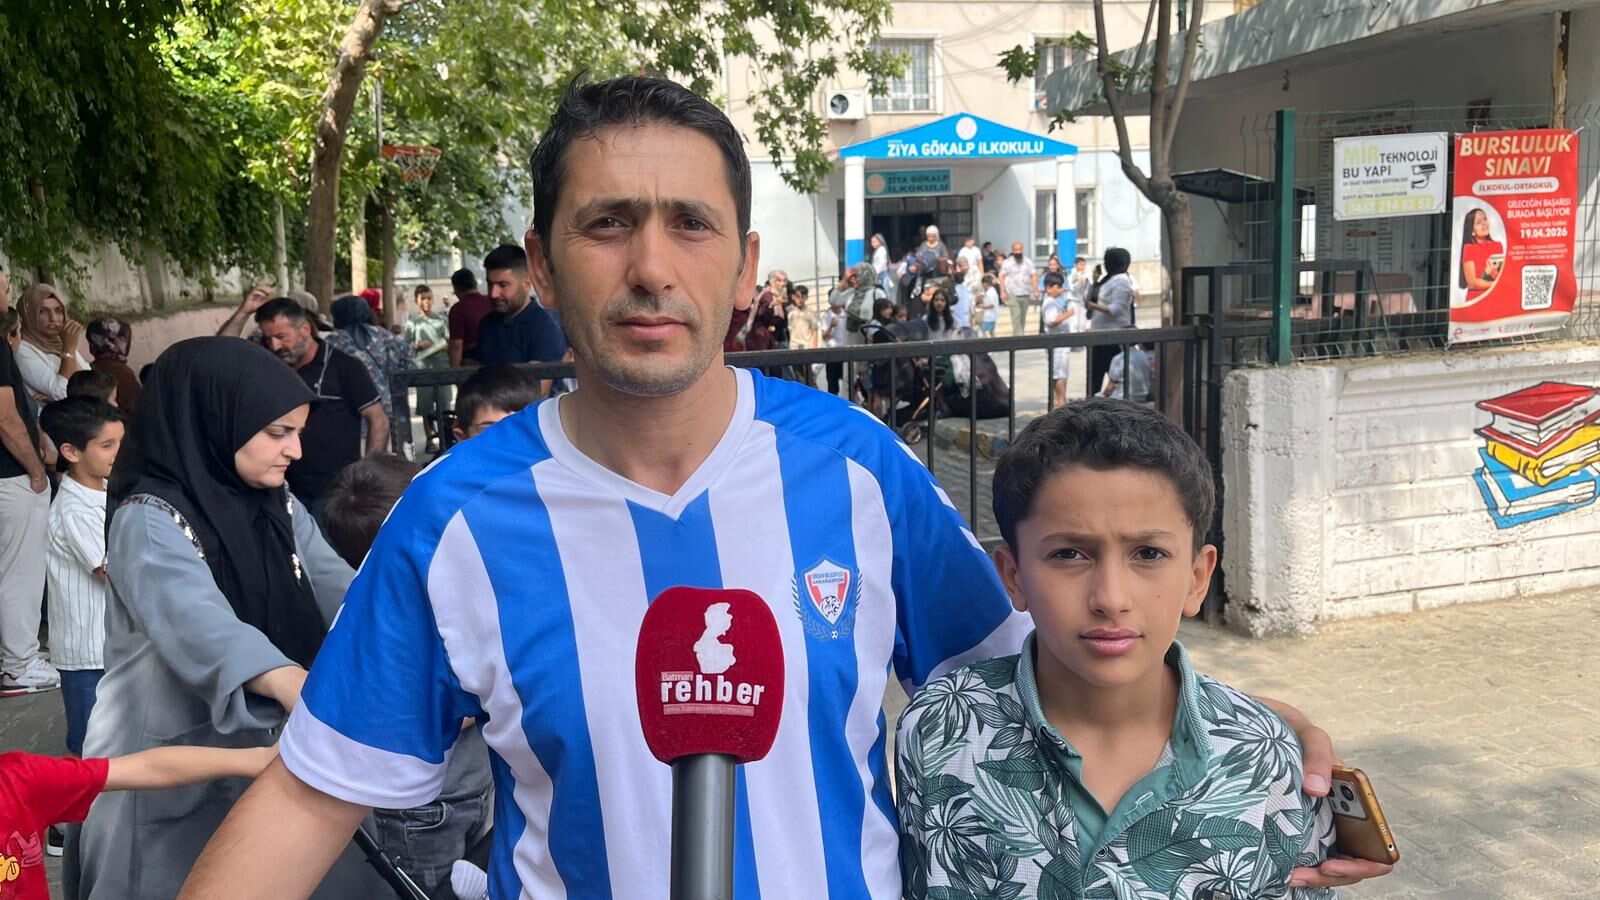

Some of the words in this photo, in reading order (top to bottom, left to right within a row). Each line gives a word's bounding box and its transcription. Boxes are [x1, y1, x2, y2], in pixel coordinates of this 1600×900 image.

[888, 143, 916, 157] ZİYA
[922, 140, 975, 156] GÖKALP
[1460, 134, 1573, 157] BURSLULUK
[1380, 146, 1438, 164] TEKNOLOJİ
[1343, 168, 1360, 178] BU
[1364, 165, 1391, 177] YAPI
[1485, 156, 1551, 177] SINAVI
[910, 173, 949, 183] GÖKALP
[888, 183, 949, 193] İLKOKULU
[1520, 227, 1568, 239] 19.04.2026
[662, 672, 693, 681] Batman
[661, 674, 765, 705] rehber
